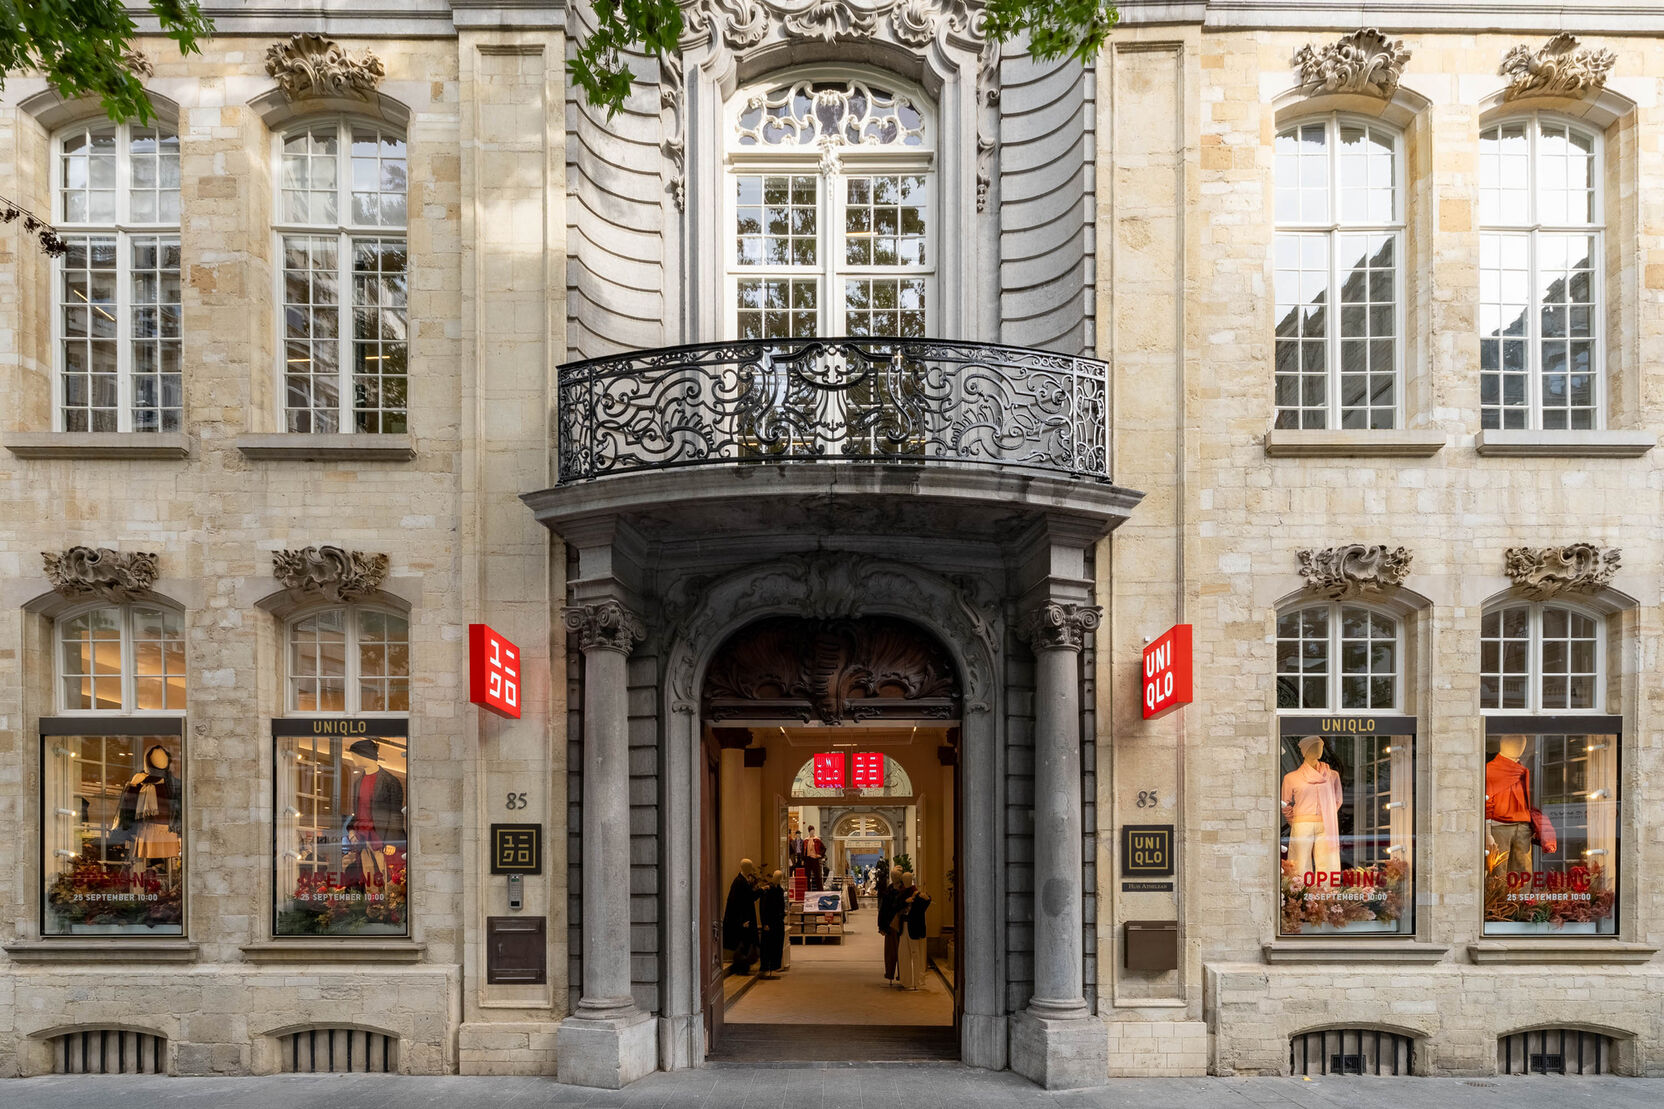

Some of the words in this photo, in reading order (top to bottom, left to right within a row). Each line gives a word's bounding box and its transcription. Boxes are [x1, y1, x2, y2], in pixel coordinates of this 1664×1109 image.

[489, 638, 517, 677] ユニ
[1145, 640, 1171, 678] UNI
[489, 672, 518, 708] クロ
[1146, 671, 1174, 711] QLO
[313, 720, 367, 735] UNIQLO
[1322, 719, 1376, 734] UNIQLO
[505, 792, 528, 811] 85
[1136, 790, 1158, 809] 85
[503, 835, 529, 848] ユニ
[1134, 836, 1160, 849] UNI
[502, 850, 530, 862] クロ
[1134, 850, 1162, 866] QLO
[73, 872, 160, 888] OPENING
[300, 871, 385, 888] OPENING
[1303, 871, 1388, 888] OPENING
[1506, 871, 1591, 888] OPENING
[73, 894, 83, 902] 25
[85, 894, 135, 902] SEPTEMBER
[137, 894, 158, 902] 10:00
[300, 894, 310, 902] 25
[312, 894, 362, 902] SEPTEMBER
[364, 894, 385, 902] 10:00
[1303, 893, 1313, 901] 25
[1314, 893, 1365, 901] SEPTEMBER
[1366, 893, 1388, 901] 10:00
[1506, 893, 1517, 901] 25
[1519, 893, 1568, 901] SEPTEMBER
[1570, 893, 1591, 901] 10:00
